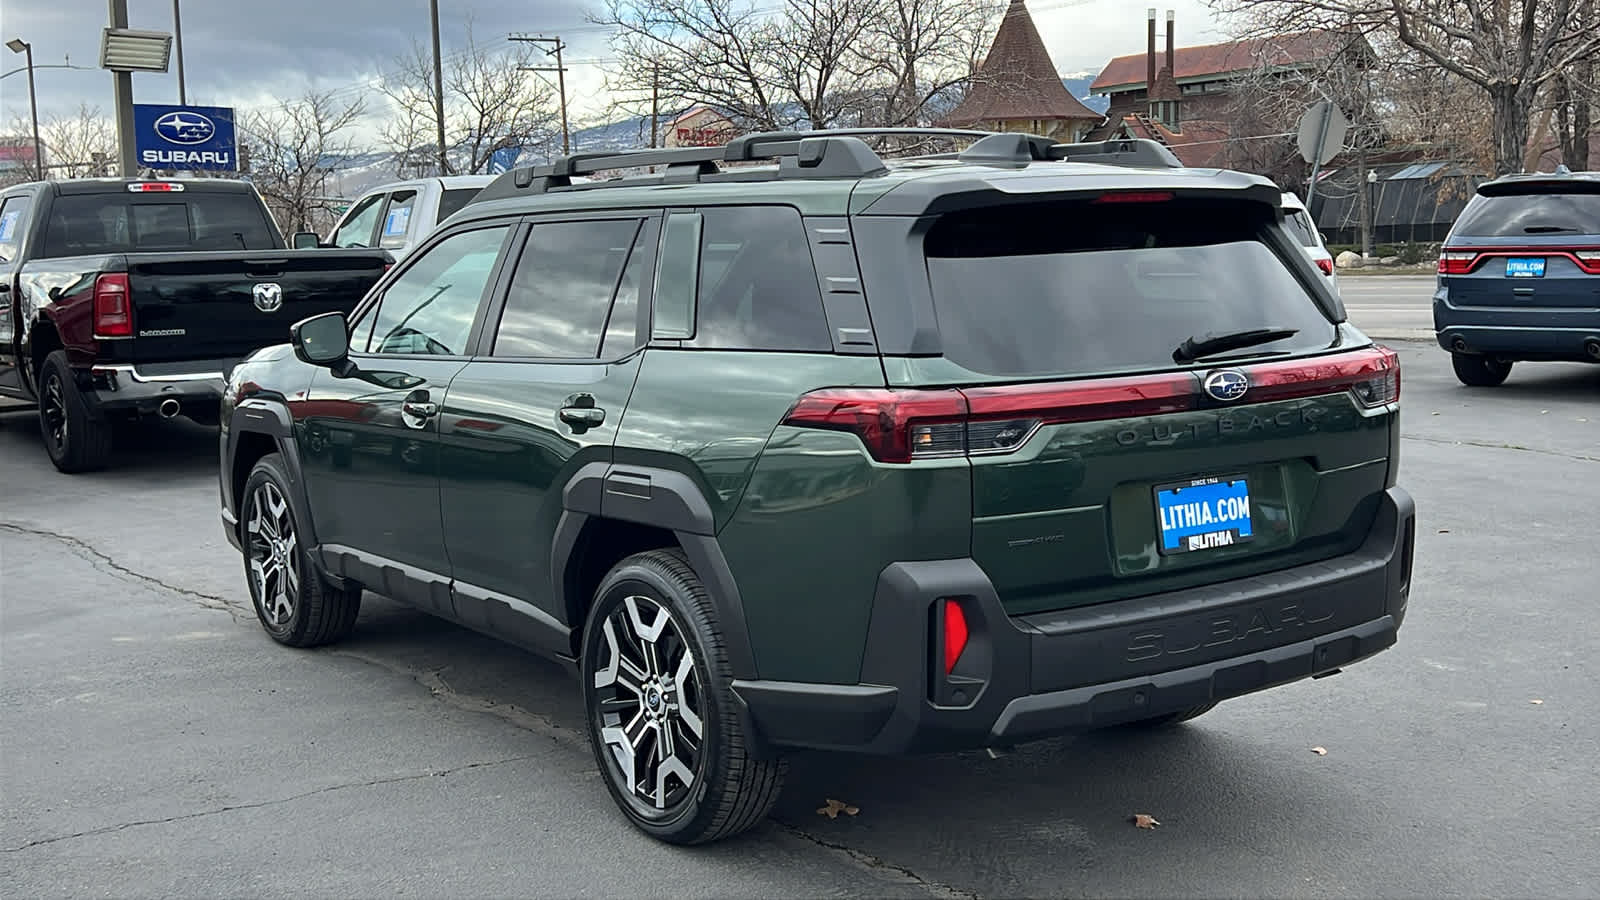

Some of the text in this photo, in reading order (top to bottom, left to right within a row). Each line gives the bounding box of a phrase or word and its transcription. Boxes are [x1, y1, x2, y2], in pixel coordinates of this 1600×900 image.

[142, 150, 229, 164] SUBARU
[1506, 263, 1544, 271] LITHIA.COM
[1115, 407, 1320, 446] OUTBACK
[1160, 495, 1250, 531] LITHIA.COM
[1200, 530, 1234, 548] LITHIA
[1127, 602, 1336, 662] SUBARU
